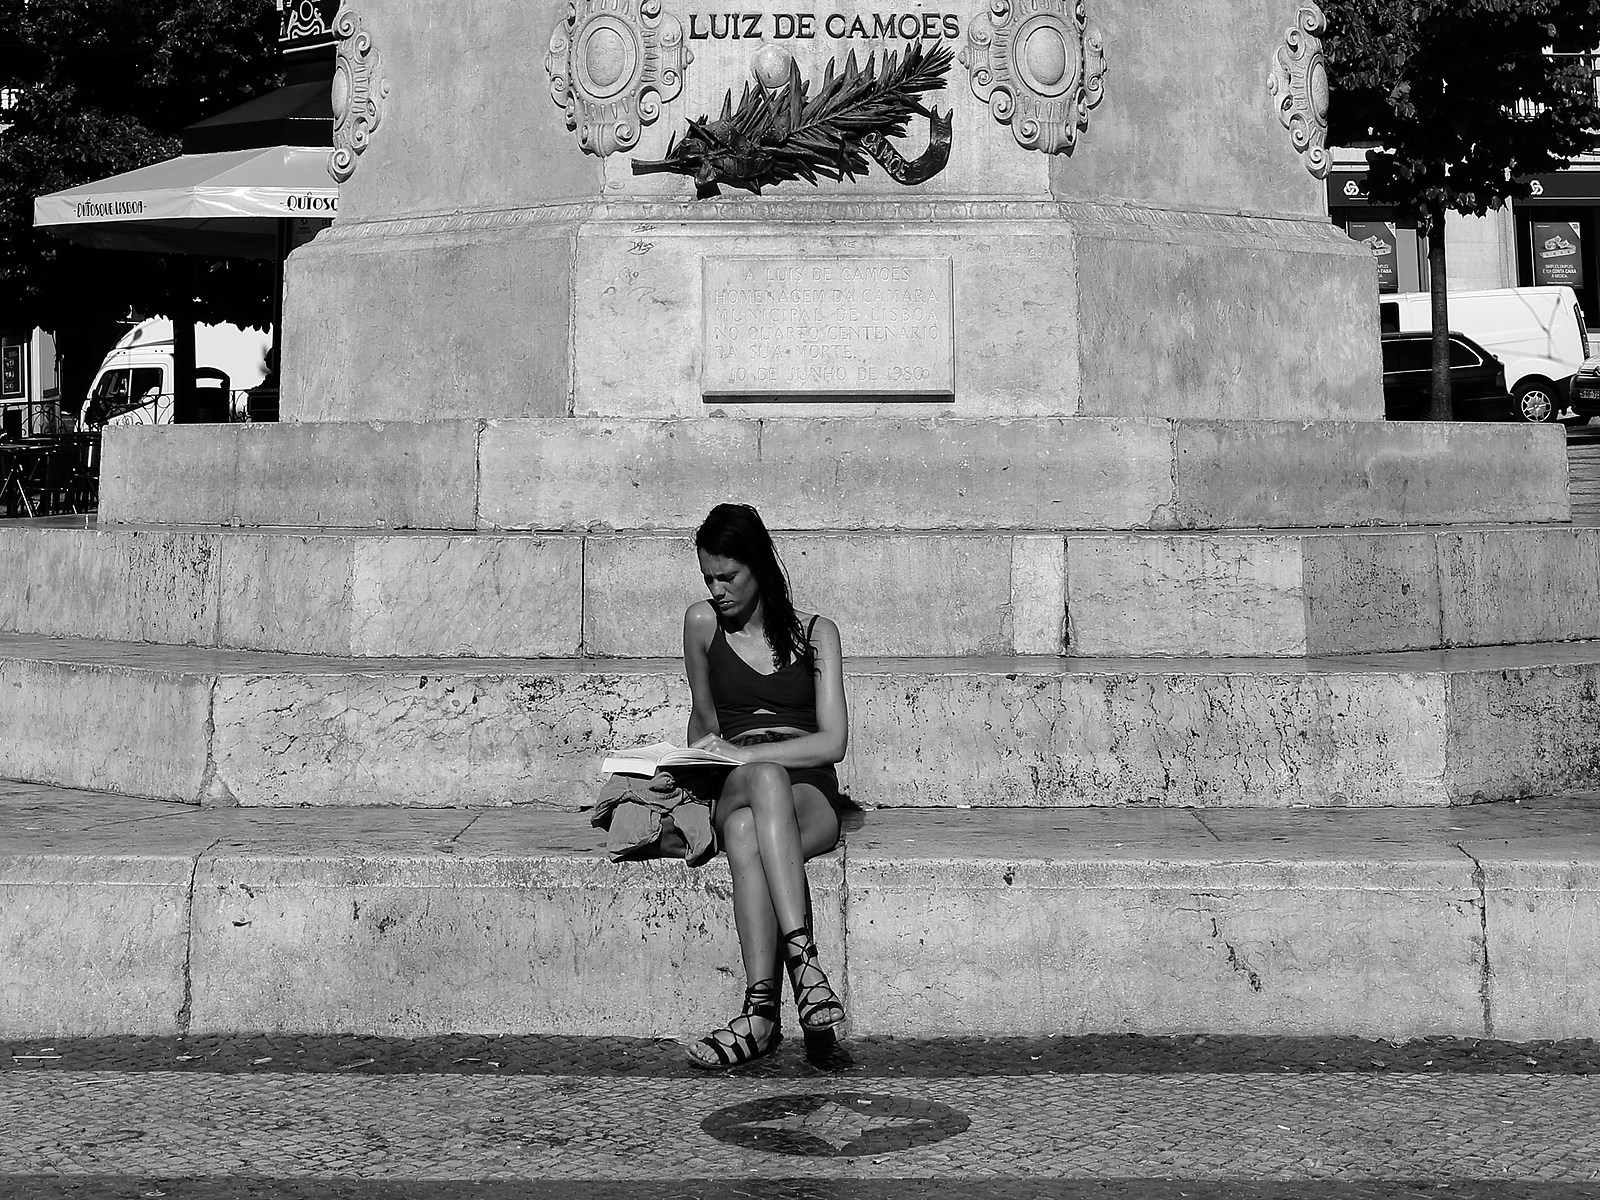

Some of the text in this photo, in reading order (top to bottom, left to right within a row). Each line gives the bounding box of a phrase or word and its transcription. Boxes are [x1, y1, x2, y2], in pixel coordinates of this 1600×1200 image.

[688, 13, 960, 40] LUIZ DE CAMOES
[745, 267, 756, 281] A
[766, 266, 803, 282] LUIS
[813, 267, 832, 282] DE
[714, 288, 825, 304] HOMENAGEM
[833, 289, 855, 304] DA
[715, 308, 939, 322] MUNICIPAL DE LISBOA
[715, 326, 738, 340] NO
[715, 345, 737, 359] DA
[749, 344, 782, 359] SUA
[757, 367, 778, 381] DE
[786, 366, 847, 381] JUNHO
[857, 367, 878, 381] DE
